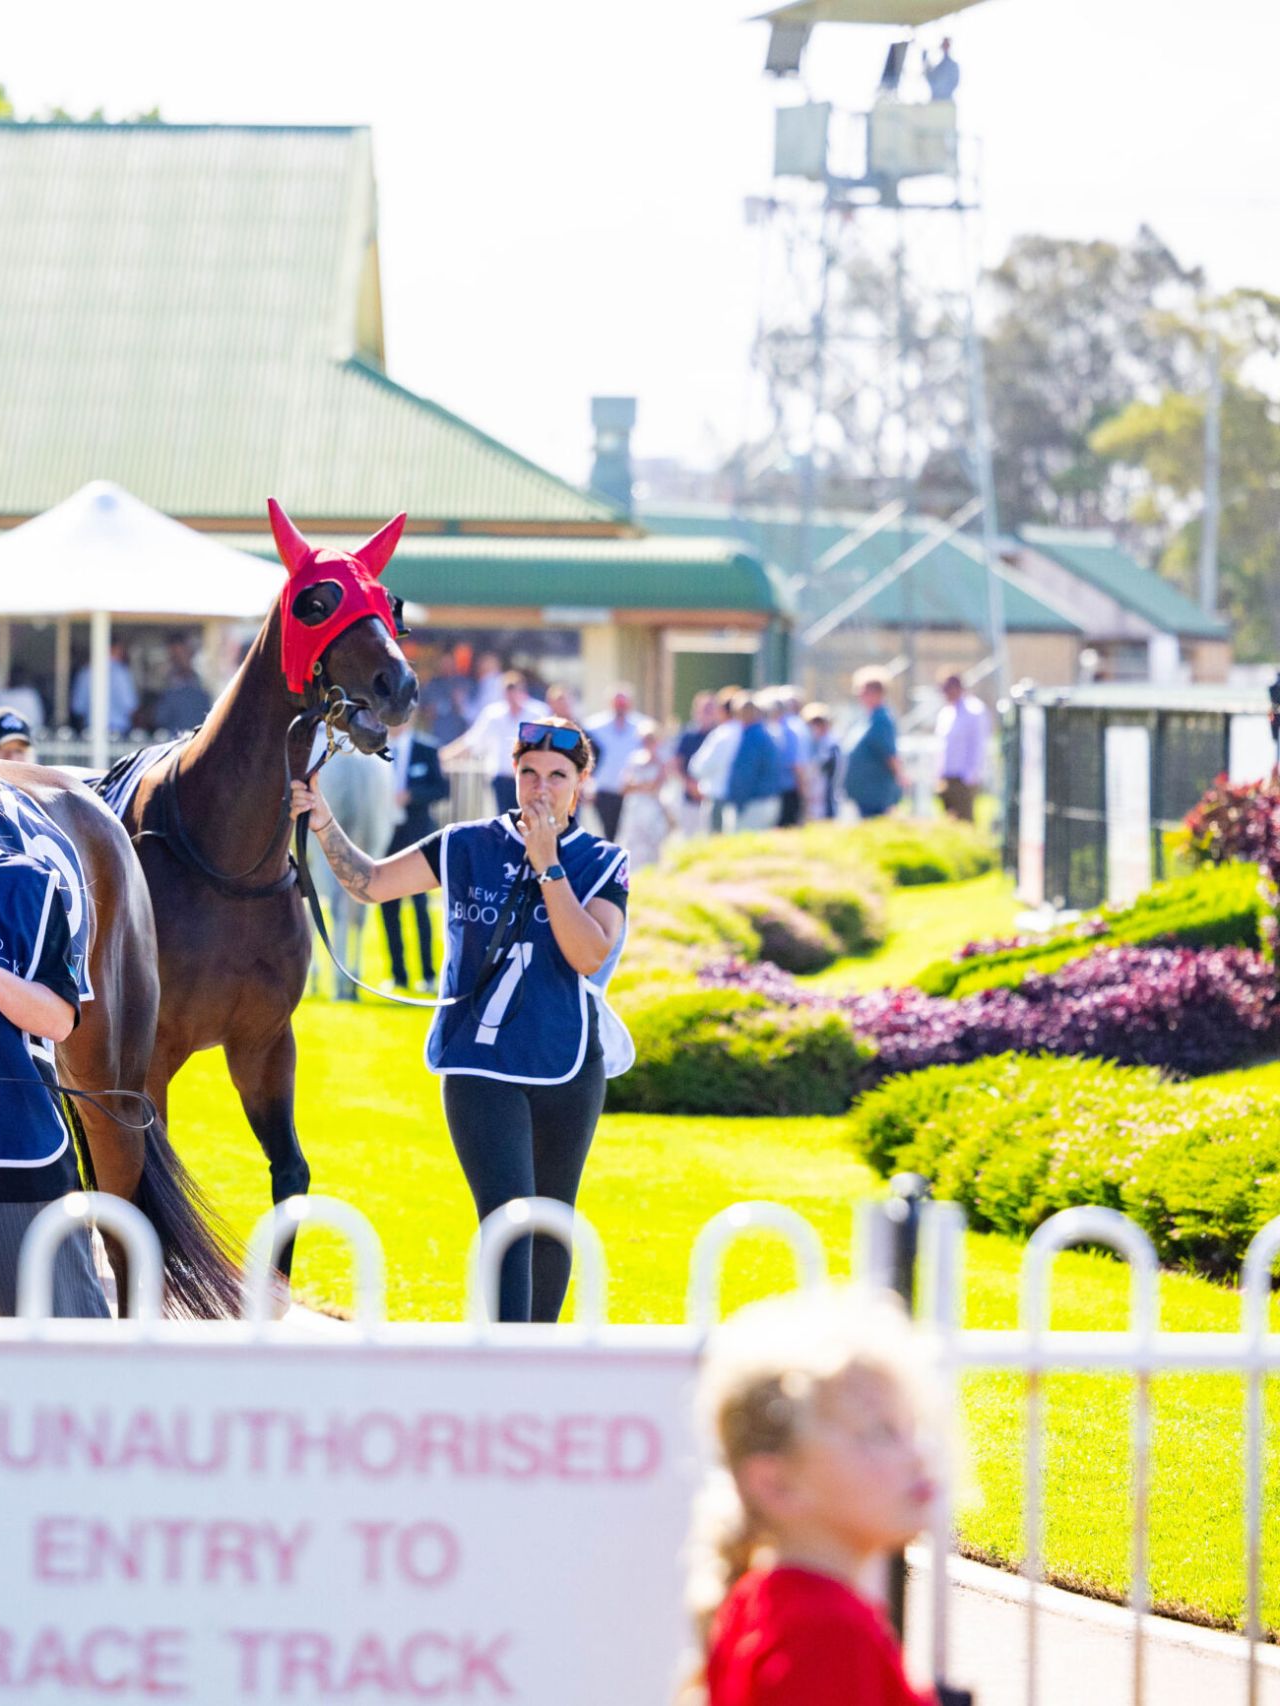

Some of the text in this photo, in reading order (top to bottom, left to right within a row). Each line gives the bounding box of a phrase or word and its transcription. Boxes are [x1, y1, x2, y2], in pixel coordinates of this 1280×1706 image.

[32, 1515, 460, 1590] ENTRY TO
[226, 1628, 516, 1700] TRACK
